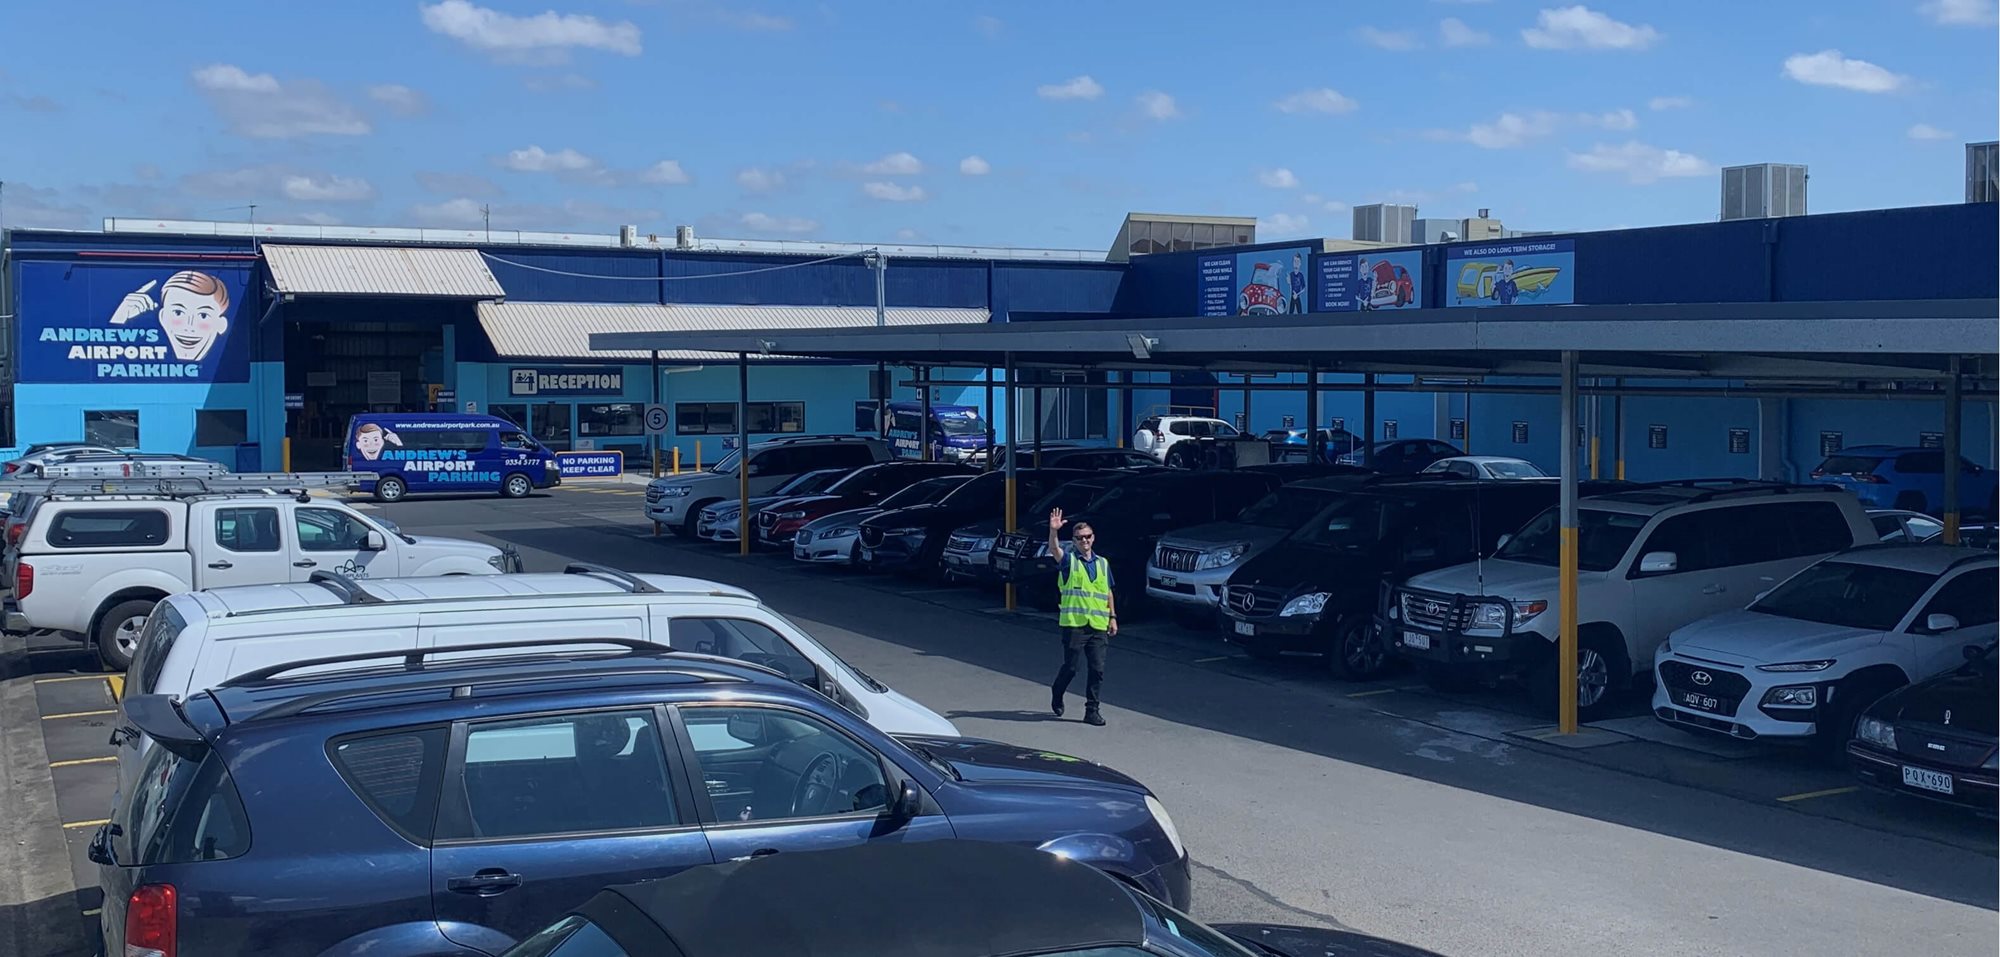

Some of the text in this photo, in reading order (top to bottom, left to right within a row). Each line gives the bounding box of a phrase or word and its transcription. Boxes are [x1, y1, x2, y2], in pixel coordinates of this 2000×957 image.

[39, 328, 159, 342] ANDREW'S
[68, 345, 167, 359] AIRPORT
[98, 364, 199, 377] PARKING
[539, 374, 621, 389] RECEPTION
[653, 414, 661, 424] 5
[382, 450, 467, 460] ANDREW'S
[404, 461, 475, 471] AIRPORT
[428, 471, 500, 482] PARKING
